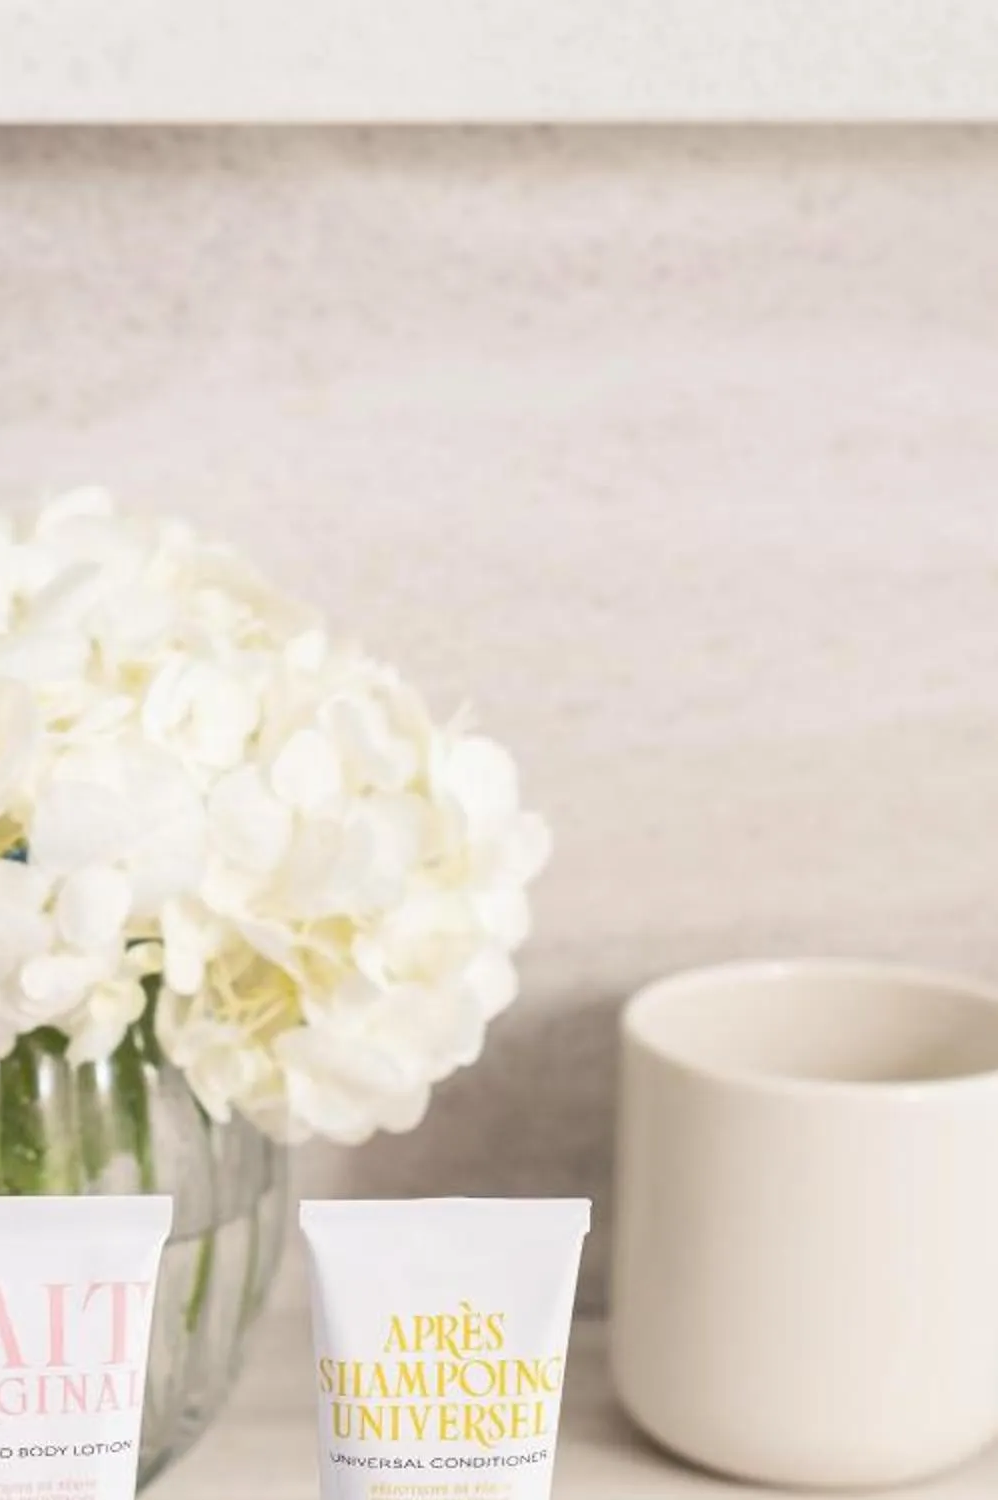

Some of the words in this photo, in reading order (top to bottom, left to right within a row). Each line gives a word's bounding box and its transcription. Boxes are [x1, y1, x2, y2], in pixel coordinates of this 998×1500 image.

[383, 1301, 505, 1360] APRÈS
[331, 1400, 548, 1448] UNIVERSEL
[19, 1445, 68, 1458] BODY
[73, 1439, 133, 1457] LOTION
[329, 1450, 424, 1470] UNIVERSAL
[429, 1450, 548, 1469] CONDITIONER
